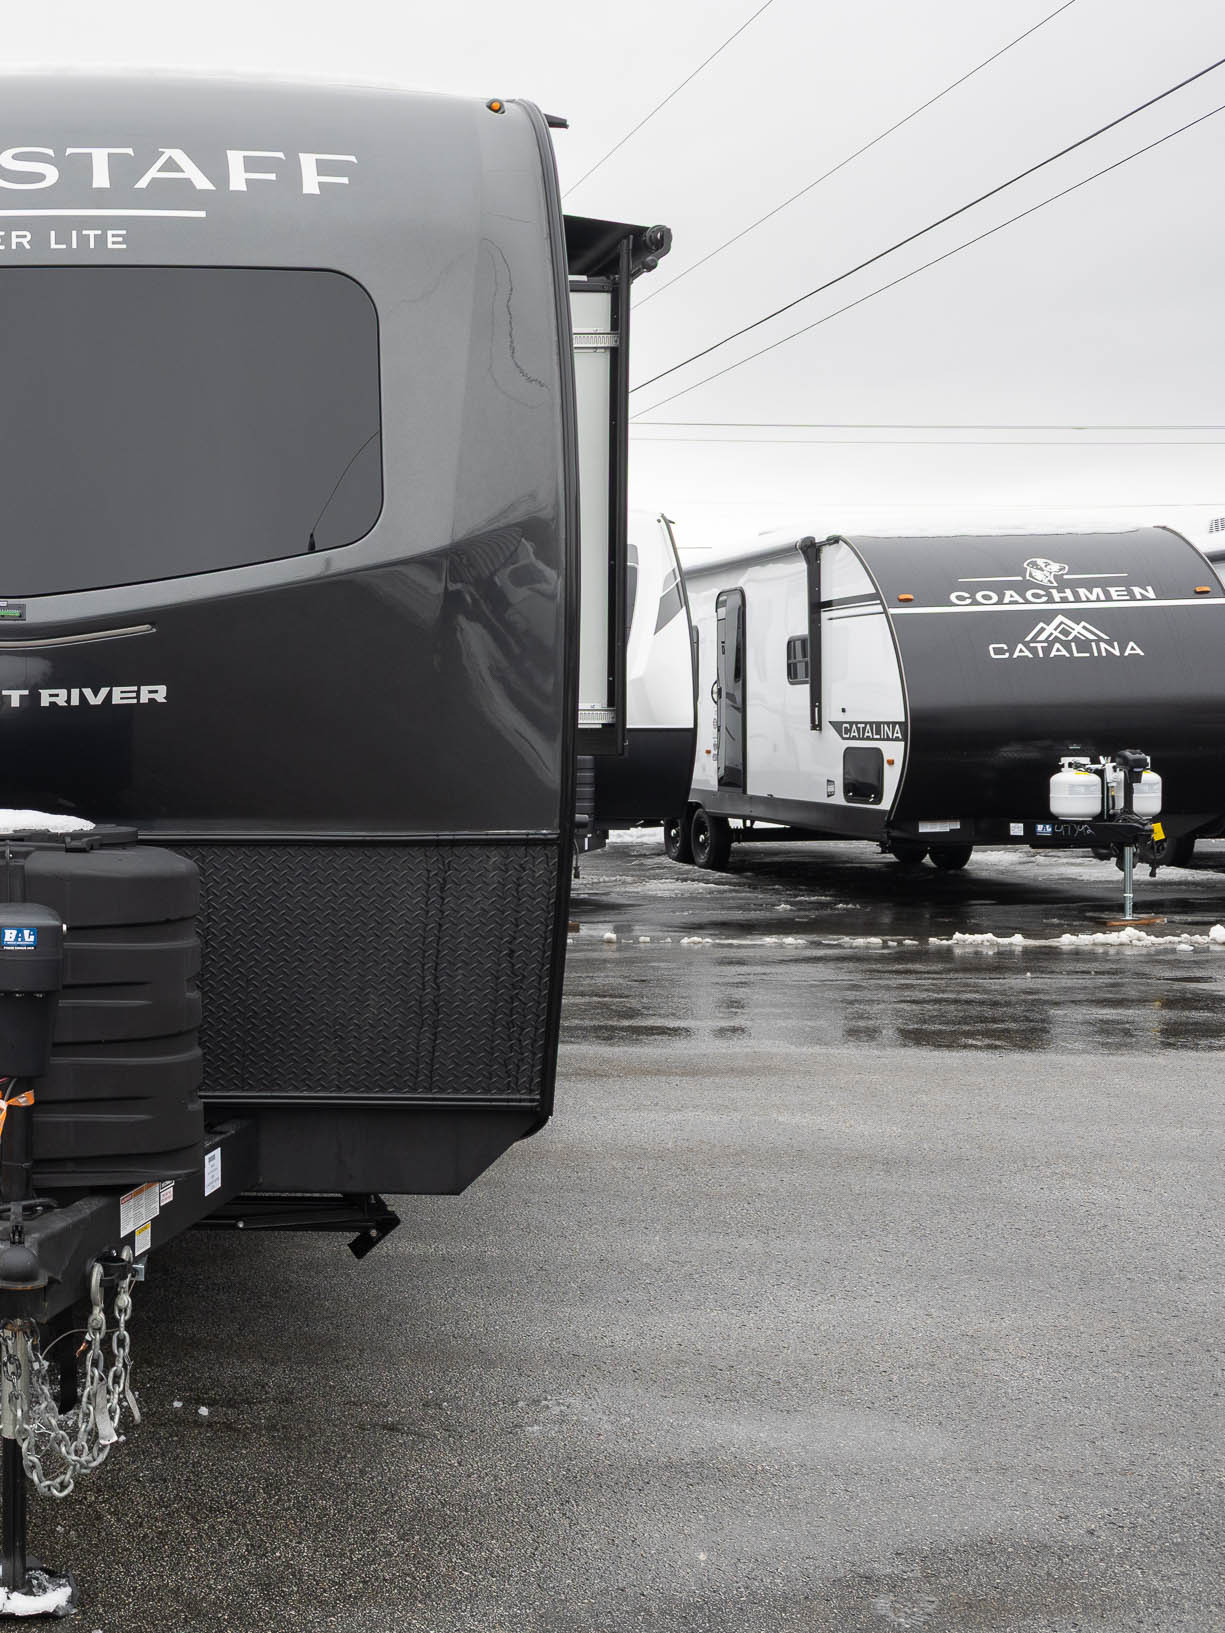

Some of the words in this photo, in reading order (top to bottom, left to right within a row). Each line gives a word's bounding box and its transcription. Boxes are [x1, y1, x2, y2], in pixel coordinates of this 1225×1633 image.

[49, 229, 127, 249] LITE
[948, 585, 1157, 605] COACHMEN
[988, 641, 1145, 659] CATALINA
[38, 684, 168, 707] RIVER
[842, 723, 902, 739] CATALINA
